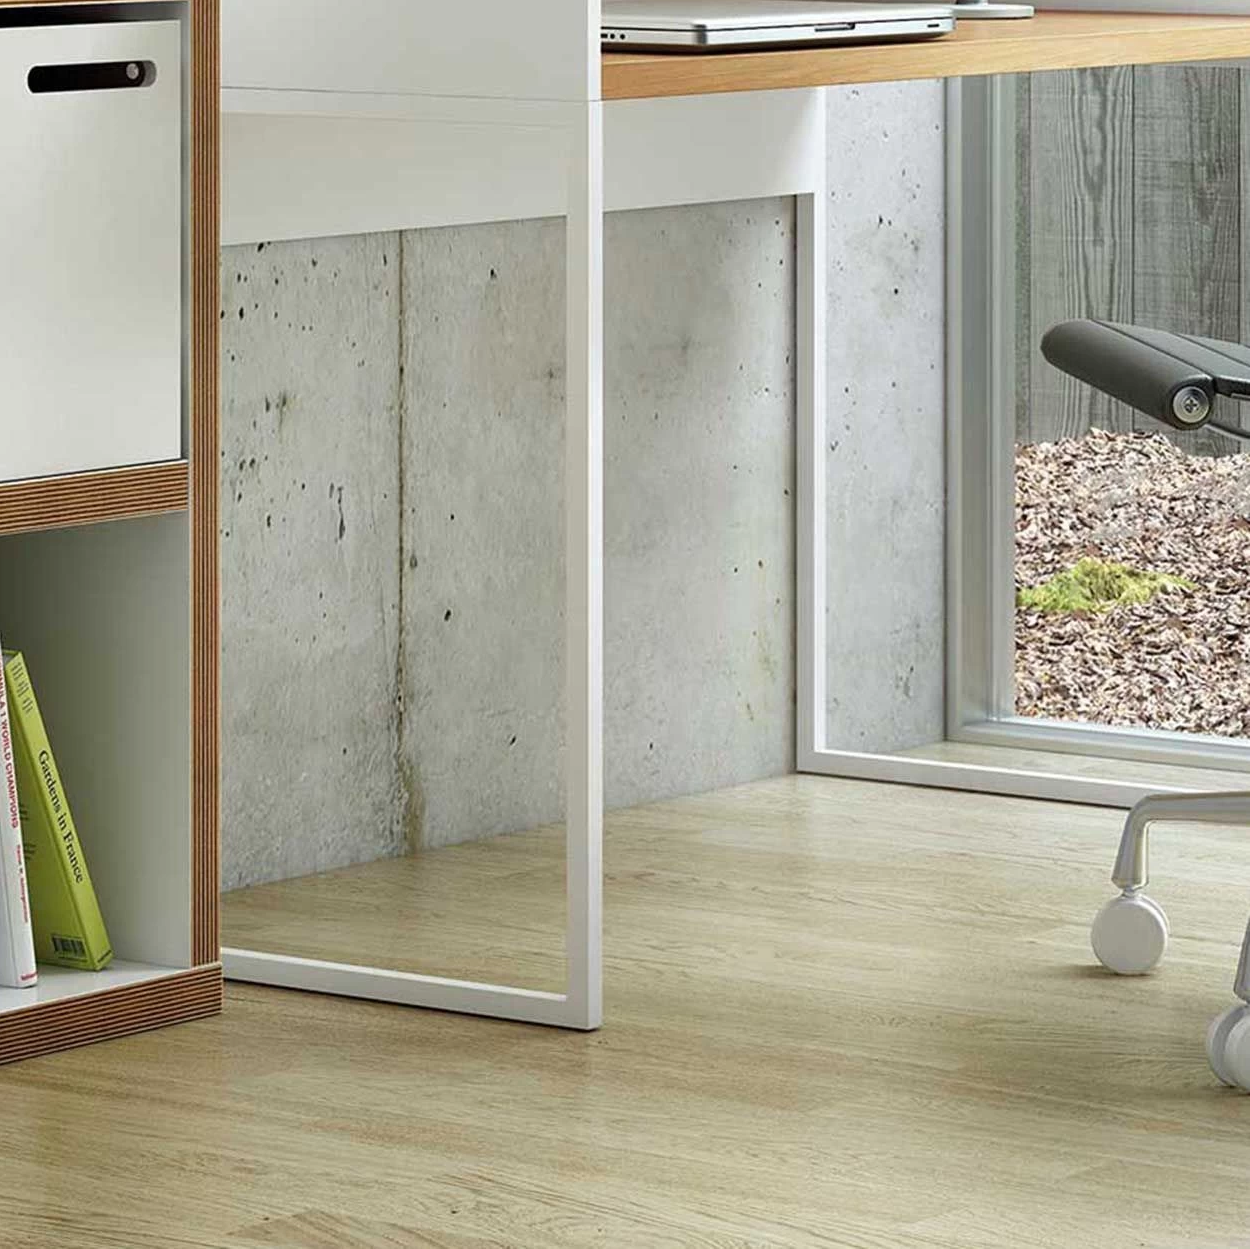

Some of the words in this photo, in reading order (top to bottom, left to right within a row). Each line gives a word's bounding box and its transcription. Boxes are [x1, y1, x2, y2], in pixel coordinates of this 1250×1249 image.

[1, 720, 12, 760] WORLD
[5, 762, 19, 829] CHAMPIONS
[38, 750, 63, 814] Gardens
[56, 814, 69, 831] in
[62, 830, 84, 884] France
